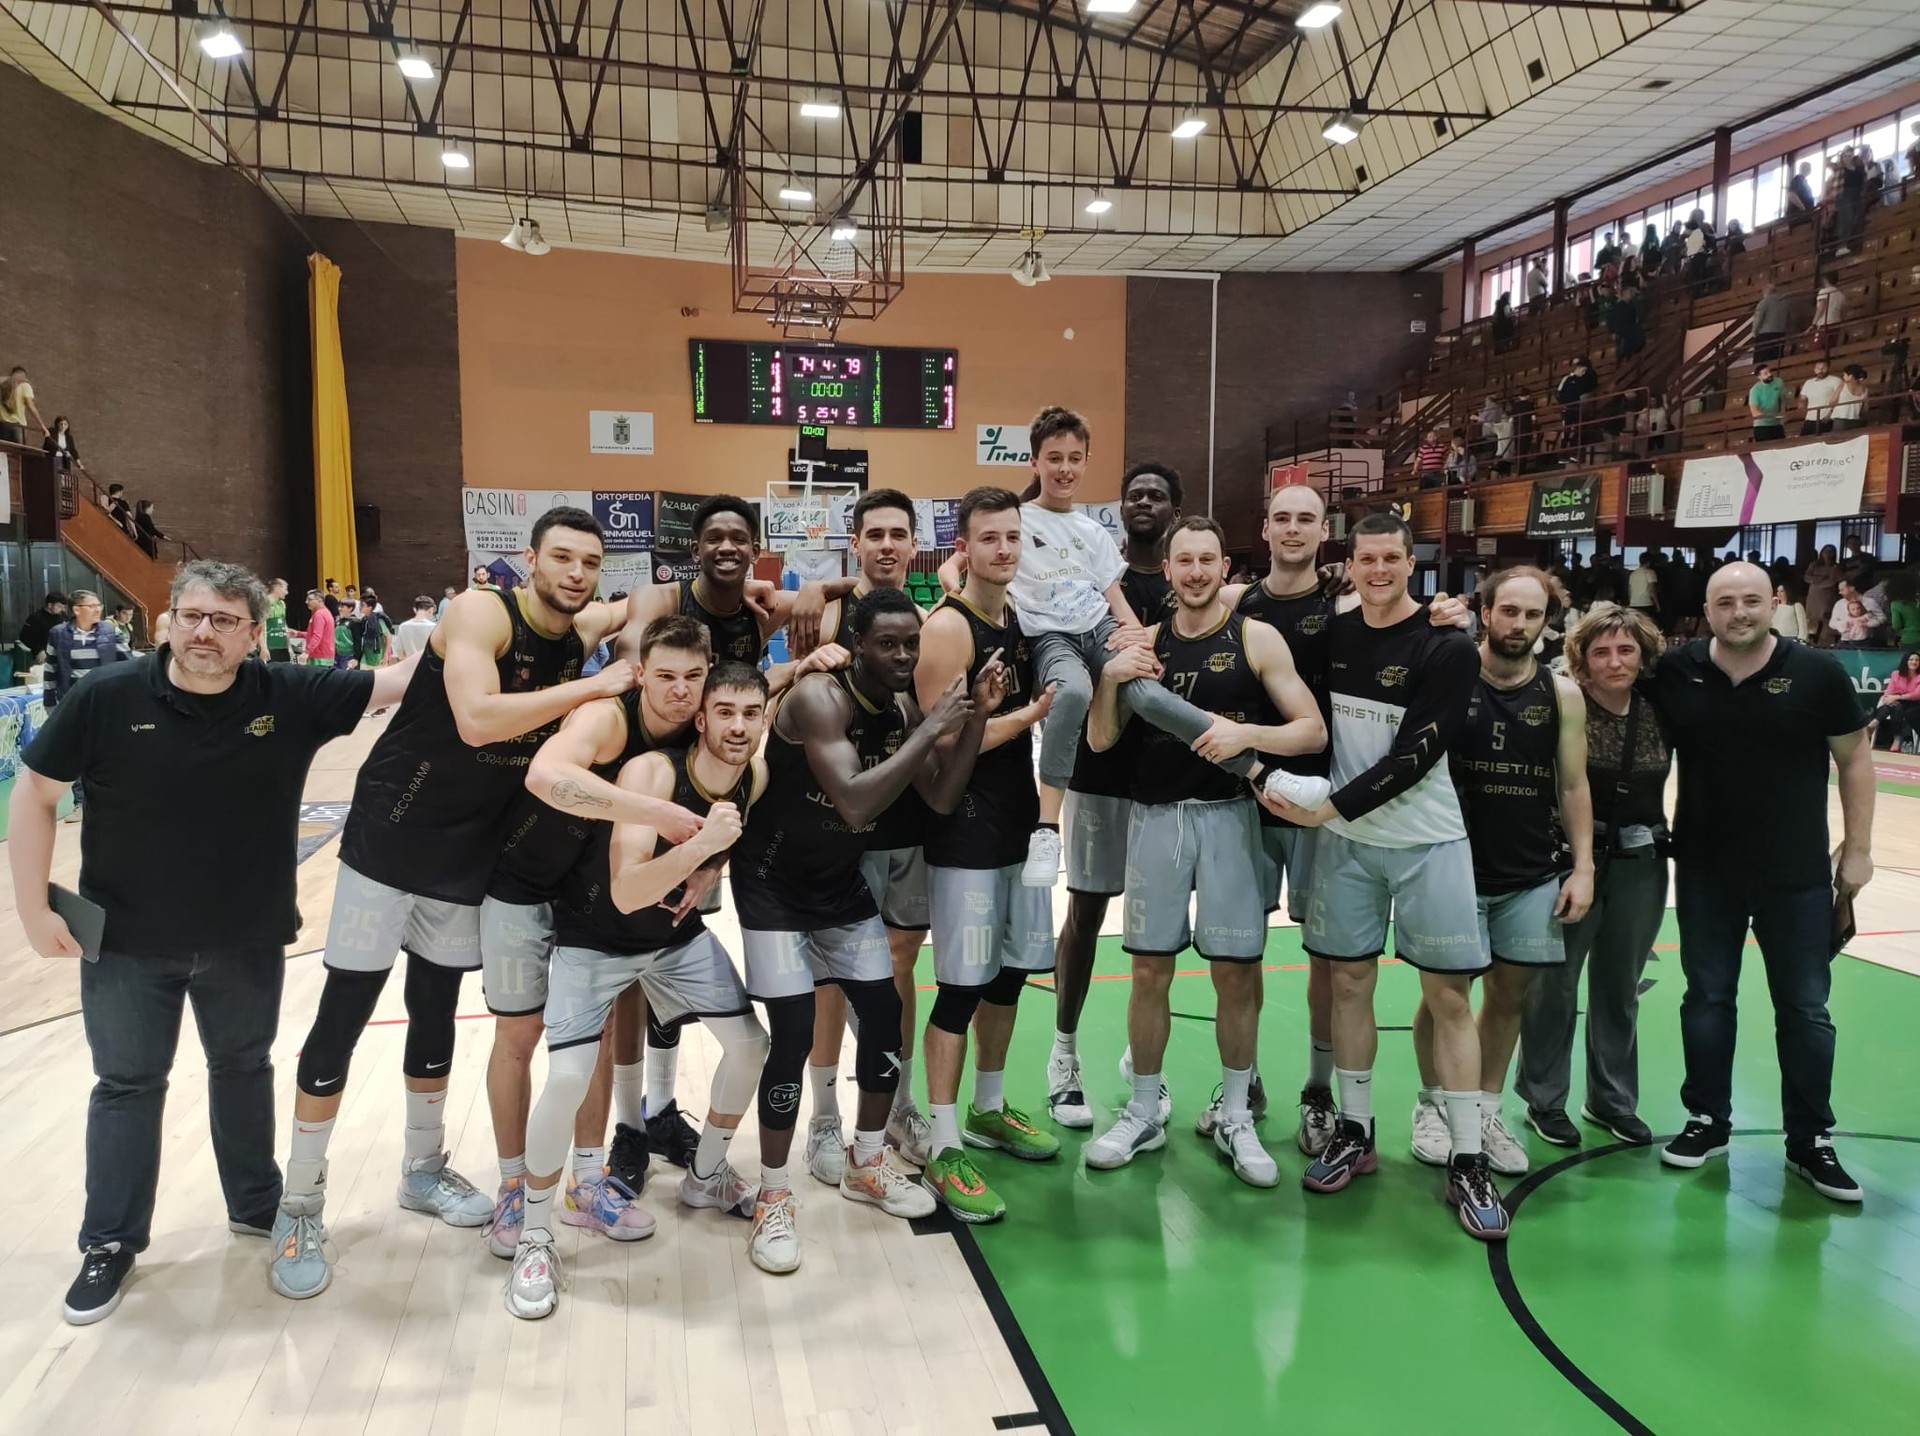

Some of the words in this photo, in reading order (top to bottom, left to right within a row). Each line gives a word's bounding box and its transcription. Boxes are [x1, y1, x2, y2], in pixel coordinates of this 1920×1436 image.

[799, 357, 814, 371] 74
[845, 358, 860, 374] 79
[811, 382, 843, 397] 00:00
[803, 426, 825, 436] 00:00
[595, 493, 651, 501] ORTOPEDIA
[1570, 510, 1585, 521] Leo
[659, 535, 676, 544] 967
[1173, 671, 1199, 699] 27
[1332, 703, 1381, 723] ARISTI
[1492, 721, 1506, 750] 5
[1462, 761, 1529, 775] ARISTI
[1484, 784, 1539, 796] GIPUZKOA
[962, 925, 993, 966] 00
